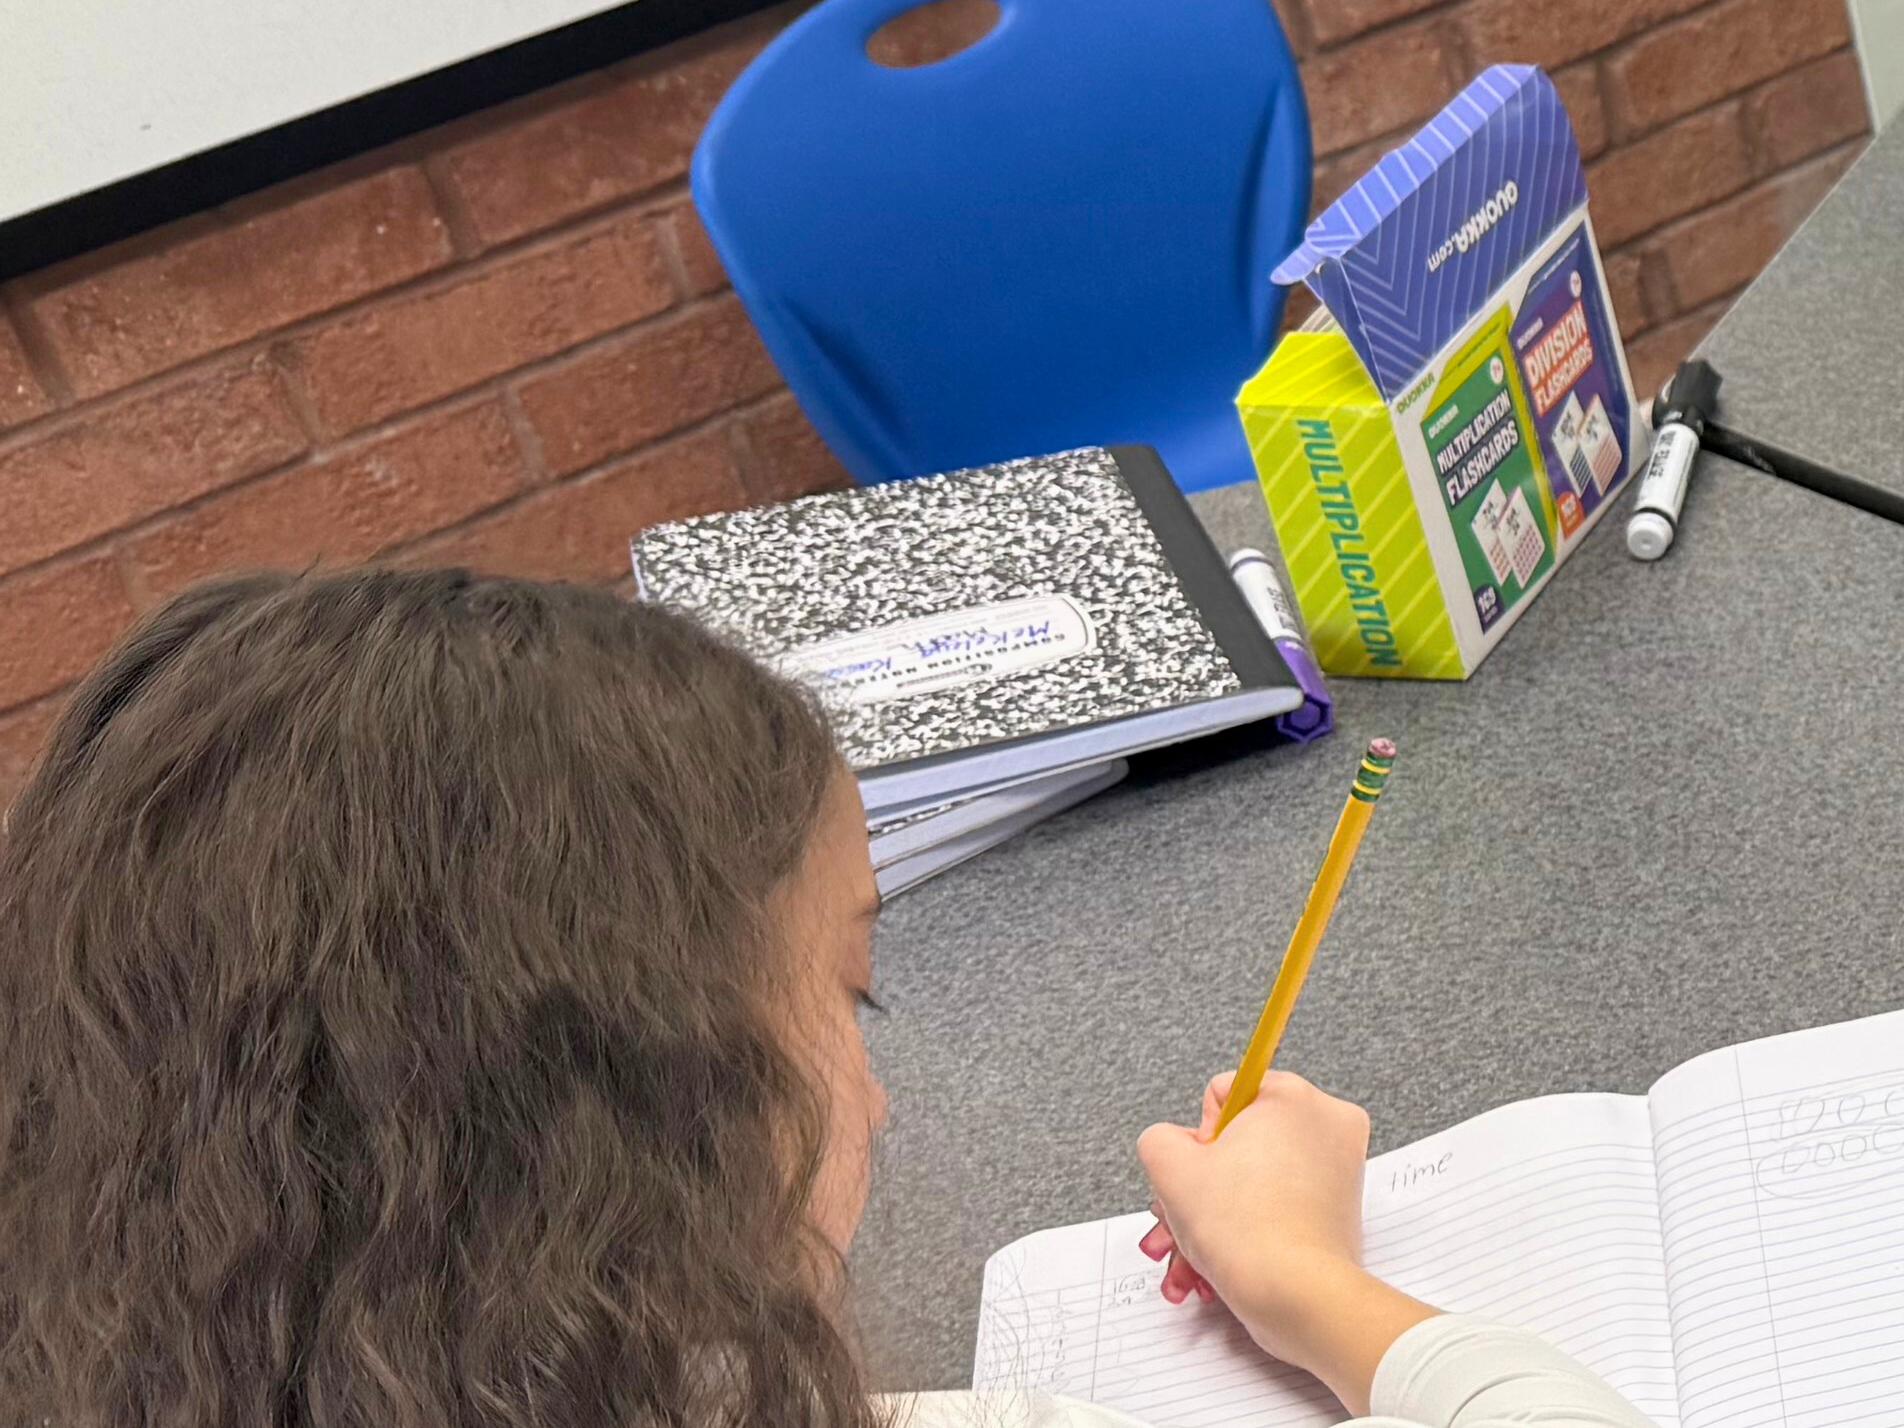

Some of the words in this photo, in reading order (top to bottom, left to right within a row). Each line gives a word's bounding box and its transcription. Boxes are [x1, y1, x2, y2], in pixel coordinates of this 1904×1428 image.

[1524, 300, 1588, 390] DIVISION
[1437, 388, 1511, 474] MULTIPLICATION
[1446, 419, 1519, 506] FLASHCARDS
[1296, 418, 1403, 668] MULTIPLICATION
